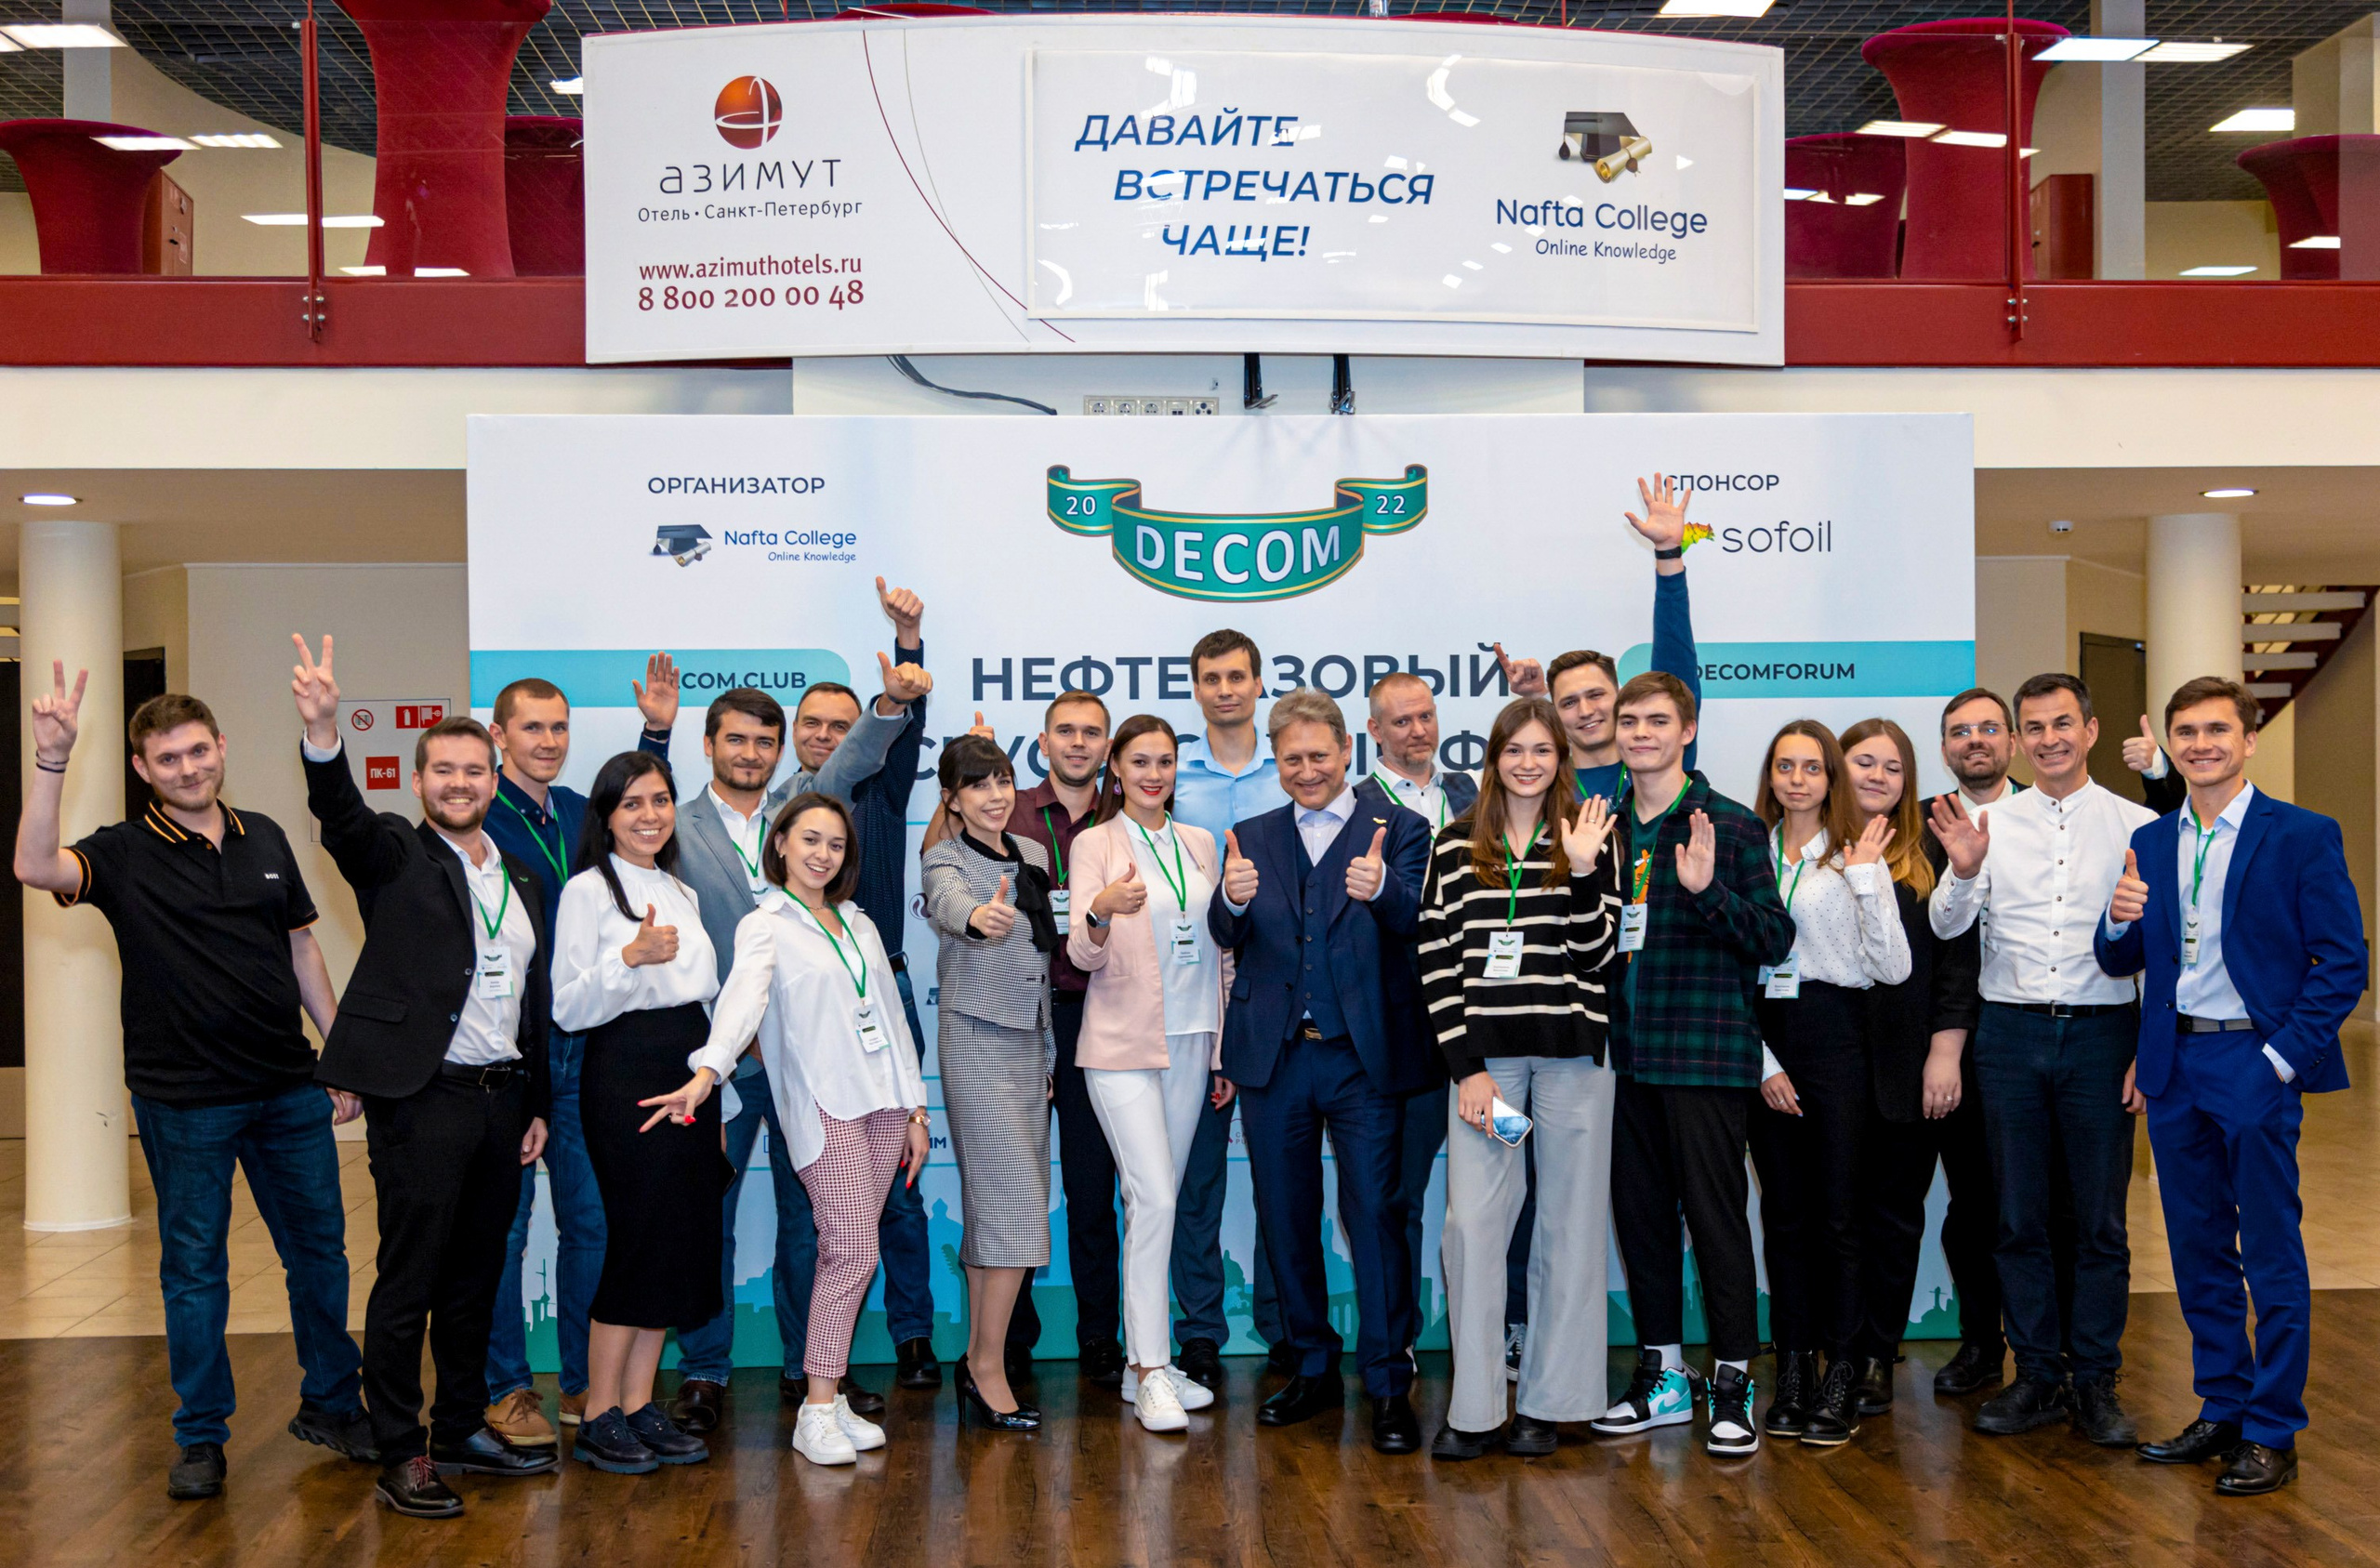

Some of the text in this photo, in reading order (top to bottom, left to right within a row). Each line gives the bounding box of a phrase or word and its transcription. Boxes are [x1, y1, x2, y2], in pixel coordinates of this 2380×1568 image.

[1074, 107, 1299, 152] ДАВАЙТЕ
[1114, 169, 1435, 205] ВСТРЕЧАТЬСЯ
[638, 200, 863, 222] Отель Санкт-Петербург
[1497, 198, 1708, 240] Nafta College
[1162, 224, 1311, 262] ЧАЩЕ!
[1535, 238, 1677, 265] Online Knowledge
[639, 253, 863, 280] www.azimuthotels.ru
[638, 279, 865, 311] 8 800 200 00 48
[647, 477, 826, 494] ОРГАНИЗАТОР
[1663, 474, 1779, 492] СПОНСОР
[1065, 495, 1096, 516] 20
[1376, 494, 1406, 514] 22
[724, 530, 857, 549] Nafta College
[1722, 520, 1831, 553] sofoil
[767, 551, 856, 564] Online Knowledge
[1135, 524, 1342, 585] DECOM
[653, 671, 807, 690] COM.CLUB
[972, 641, 1510, 701] НЕФТЕЗОВЫЙ
[370, 767, 396, 779] ПК-61
